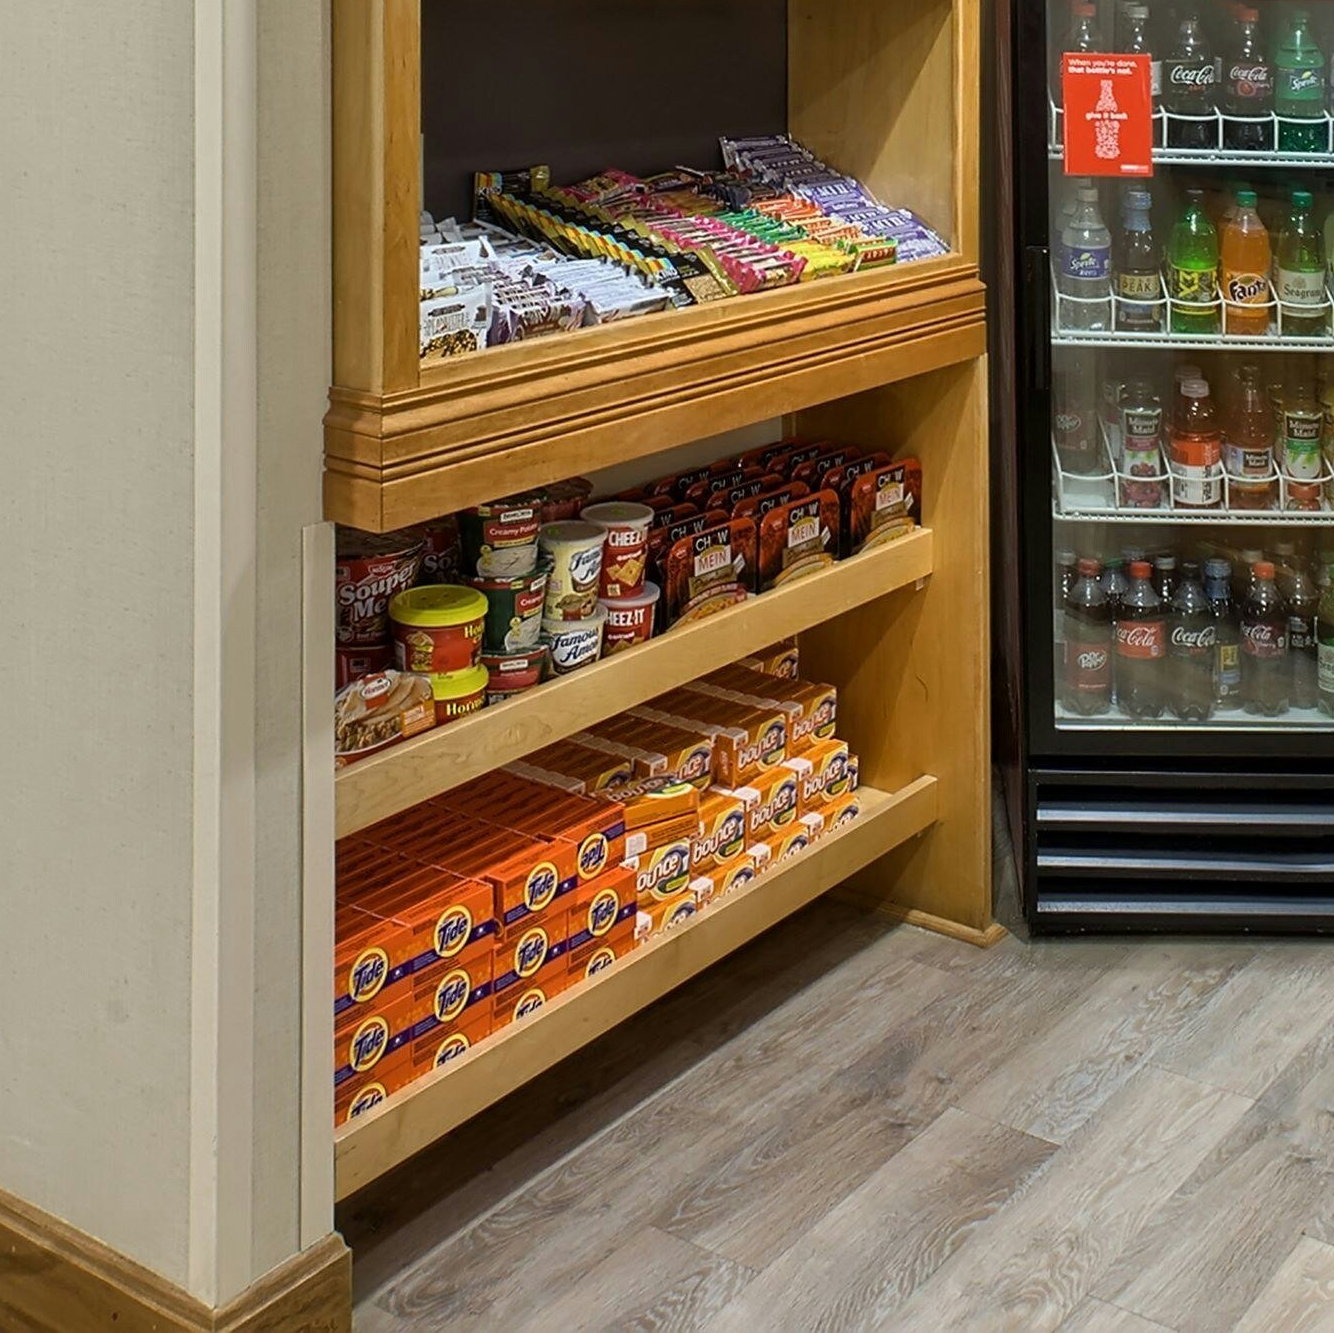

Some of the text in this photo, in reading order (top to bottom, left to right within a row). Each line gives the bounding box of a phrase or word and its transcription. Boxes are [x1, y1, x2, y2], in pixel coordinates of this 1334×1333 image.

[731, 484, 761, 504] CHW
[878, 469, 904, 488] CHW
[671, 519, 704, 542] CHW
[790, 502, 819, 523] CHW
[695, 529, 729, 552] CHW
[698, 551, 727, 571] MEIN
[353, 596, 387, 622] Me
[738, 729, 779, 773] bounce
[803, 760, 843, 802] bounce
[750, 789, 790, 832] bounce
[692, 819, 737, 866] bounce
[528, 872, 555, 906] Tide
[637, 853, 679, 892] ounce
[591, 897, 617, 932] Tide
[438, 917, 468, 953] Tide
[519, 937, 545, 973] Tide
[353, 959, 385, 999] Tide
[437, 979, 467, 1018] Tide
[354, 1027, 386, 1068] Tide
